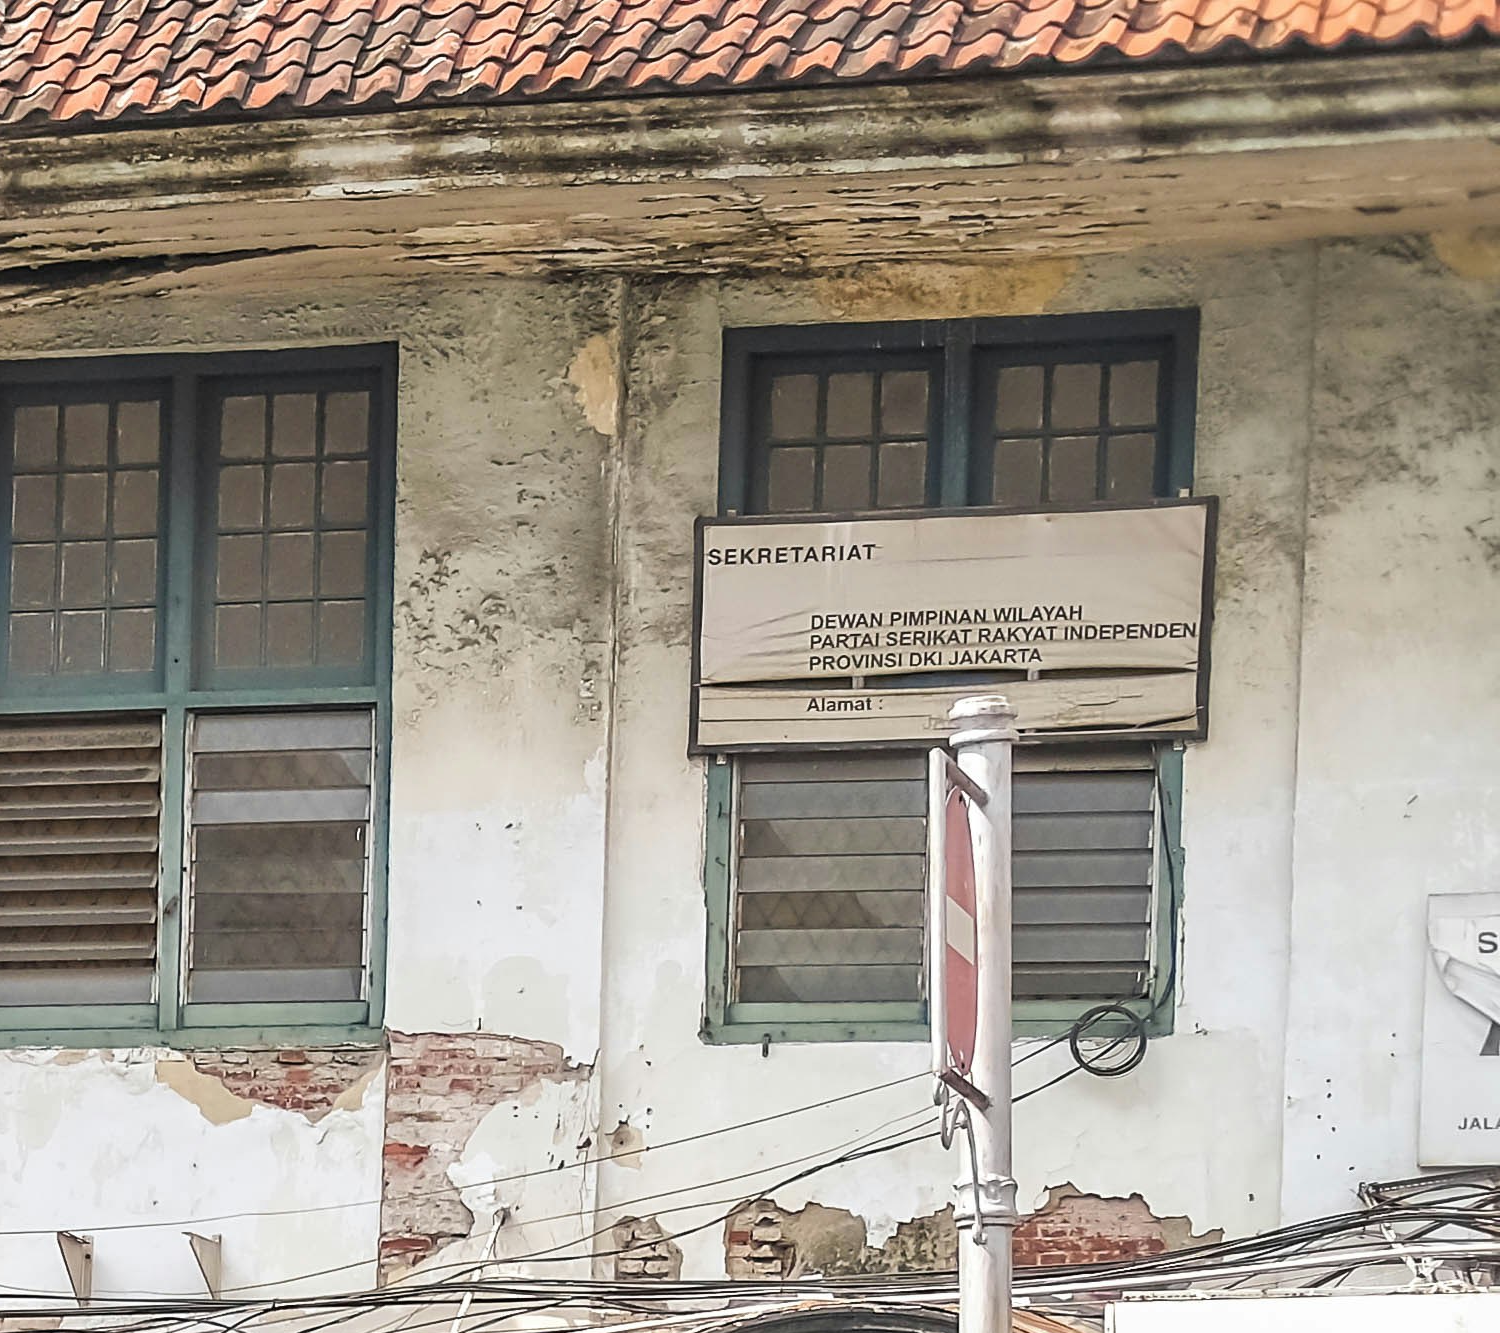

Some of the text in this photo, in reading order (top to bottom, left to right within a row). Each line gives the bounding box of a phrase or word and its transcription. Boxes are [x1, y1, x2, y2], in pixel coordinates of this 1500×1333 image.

[707, 543, 876, 566] SEKRETARIAT
[810, 605, 1083, 631] DEWAN PIMPINAN WILAYAH
[809, 621, 1197, 650] PARTAI SERIKAT RAKYAT INDEPENDEN
[808, 647, 1043, 671] PROVINSI DKI JAKARTA
[806, 695, 873, 713] Alamat
